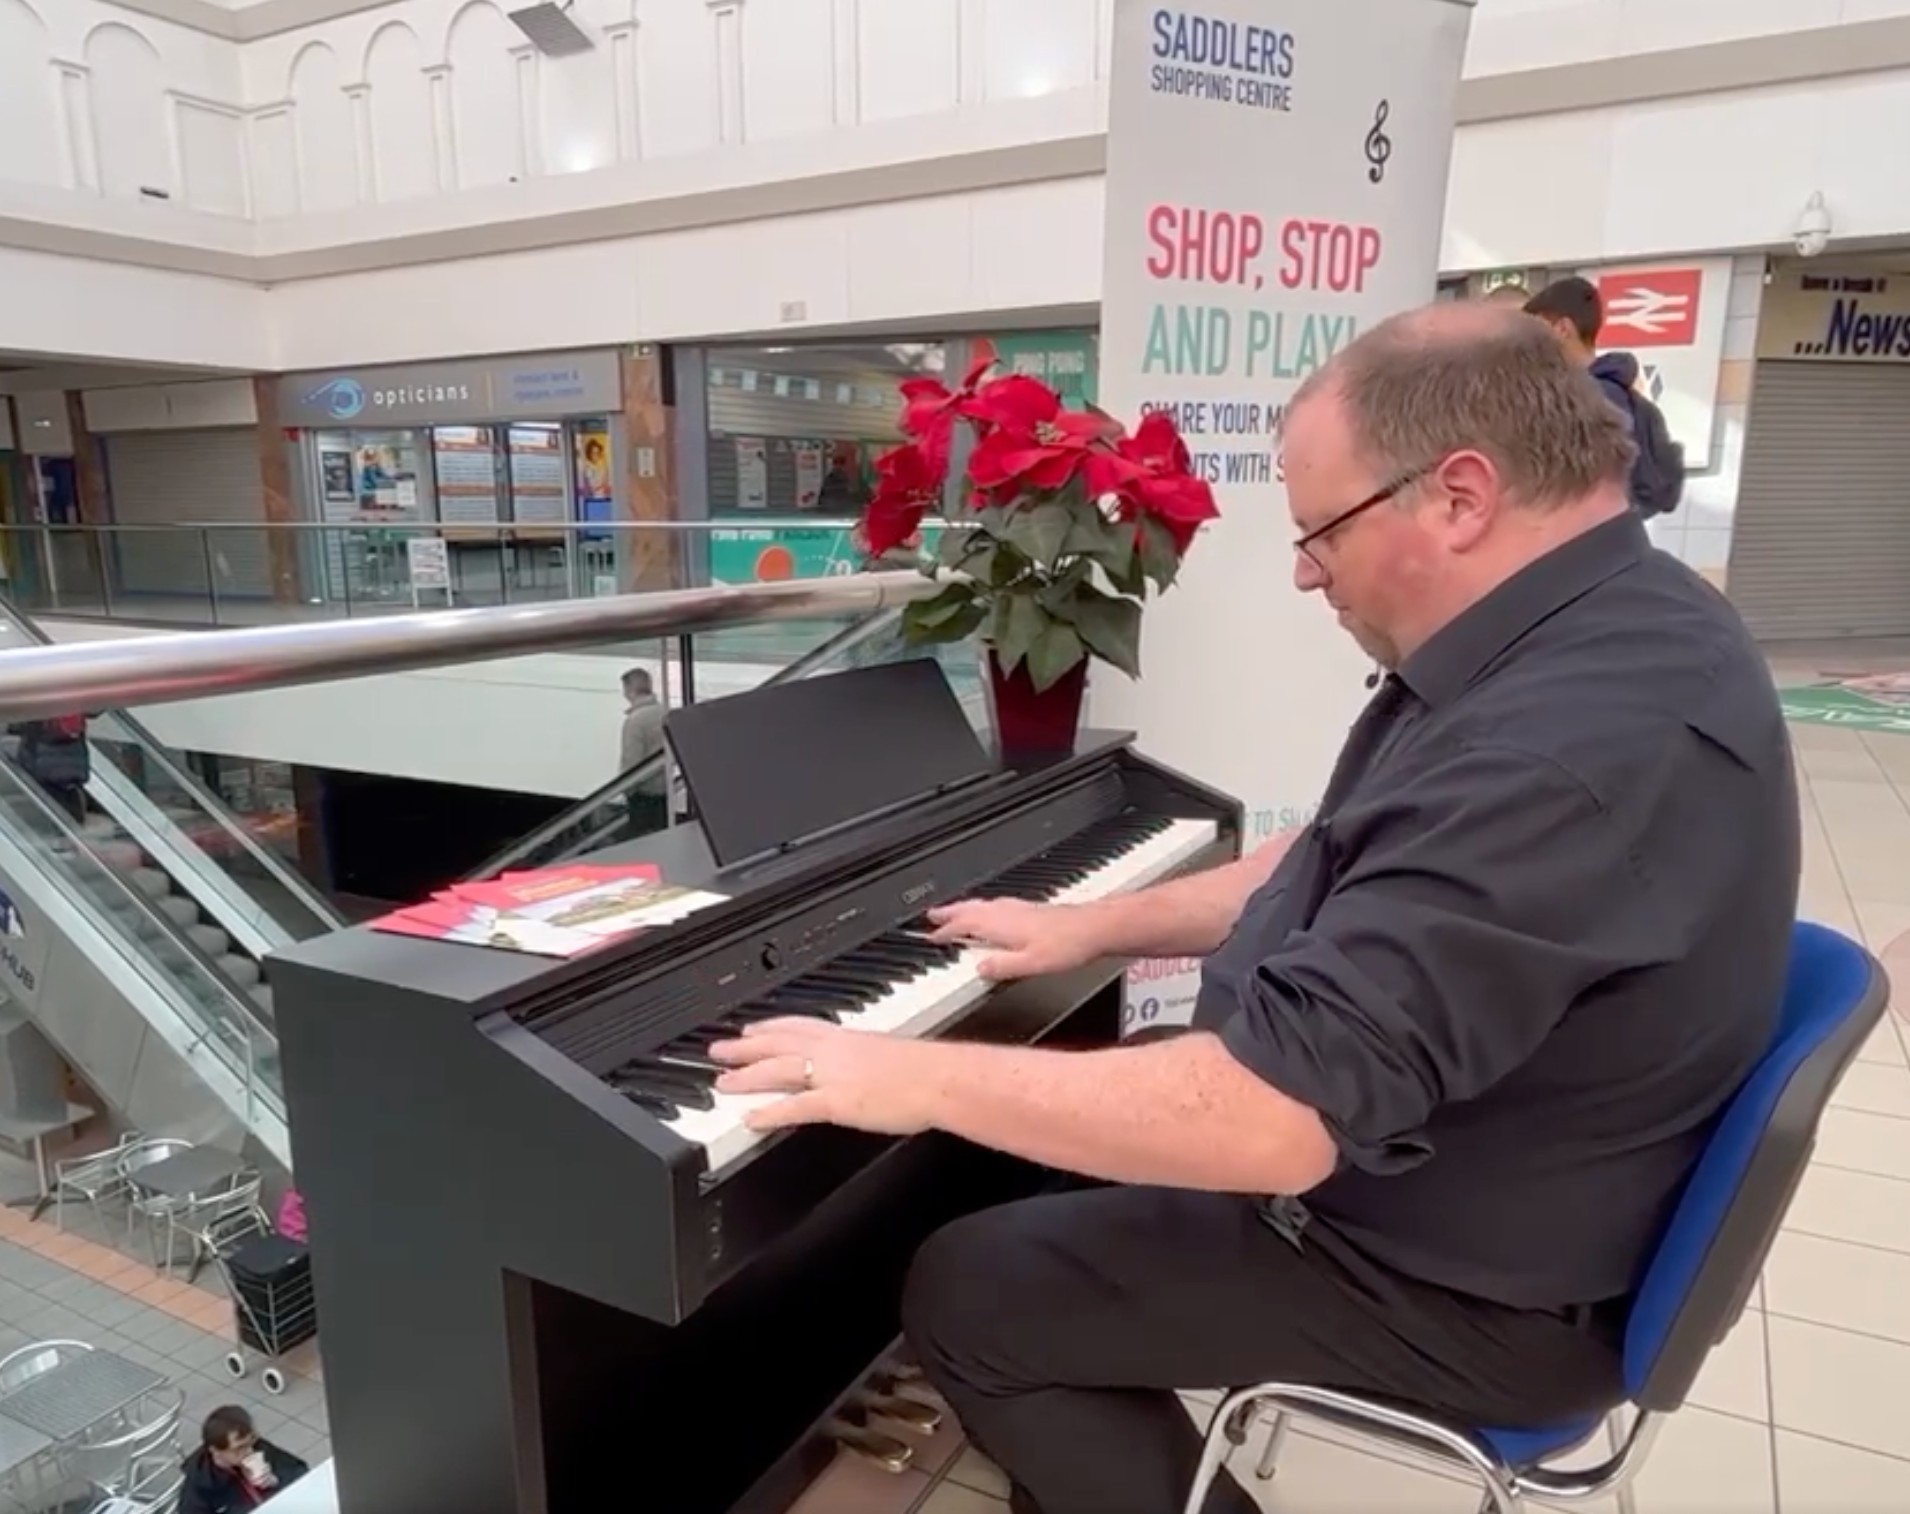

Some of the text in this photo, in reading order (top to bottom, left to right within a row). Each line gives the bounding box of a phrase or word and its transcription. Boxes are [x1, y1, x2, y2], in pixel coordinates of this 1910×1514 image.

[1153, 10, 1295, 79] SADDLERS
[1151, 64, 1291, 111] SHOPPING CENTRE
[1147, 205, 1381, 293] SHOP, STOP
[1142, 304, 1231, 376] AND
[372, 384, 469, 408] opticians
[1212, 402, 1260, 434] YOUR
[1265, 403, 1290, 434] M
[1226, 453, 1271, 484] WITH
